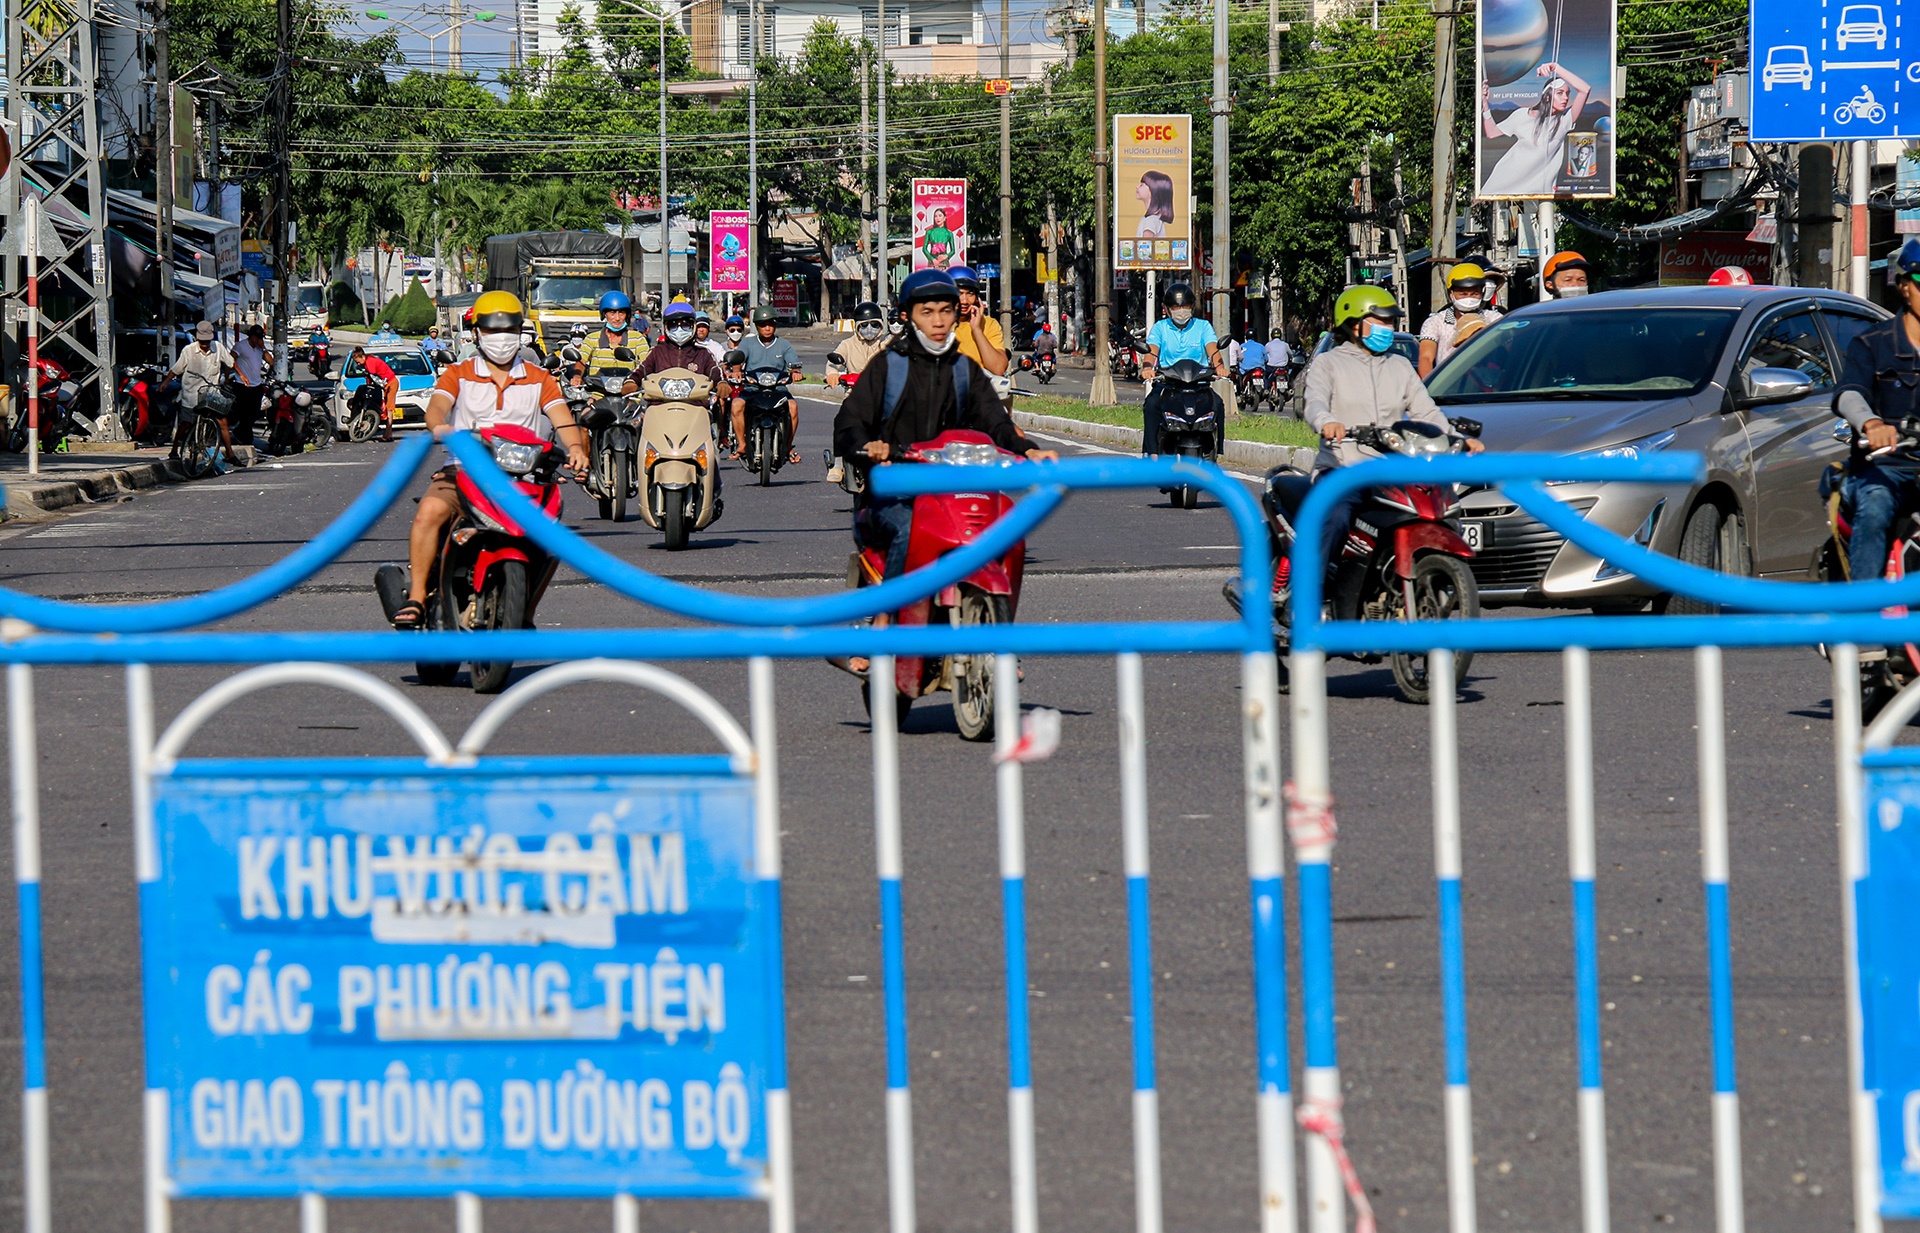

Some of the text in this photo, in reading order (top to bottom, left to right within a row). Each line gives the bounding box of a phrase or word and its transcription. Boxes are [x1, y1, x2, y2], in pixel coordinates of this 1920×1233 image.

[1136, 125, 1172, 141] SPEC
[917, 184, 963, 196] OEXPO
[1663, 248, 1697, 266] Cao
[95, 275, 104, 283] 29
[954, 493, 991, 501] HONDA
[1355, 517, 1379, 538] YAMAHA
[238, 833, 373, 919] KHU
[543, 799, 689, 916] CẤM
[204, 946, 727, 1045] CÁC PHƯƠNG TIỆN
[191, 1058, 749, 1165] GIAO THÔNG ĐƯỜNG BỘ
